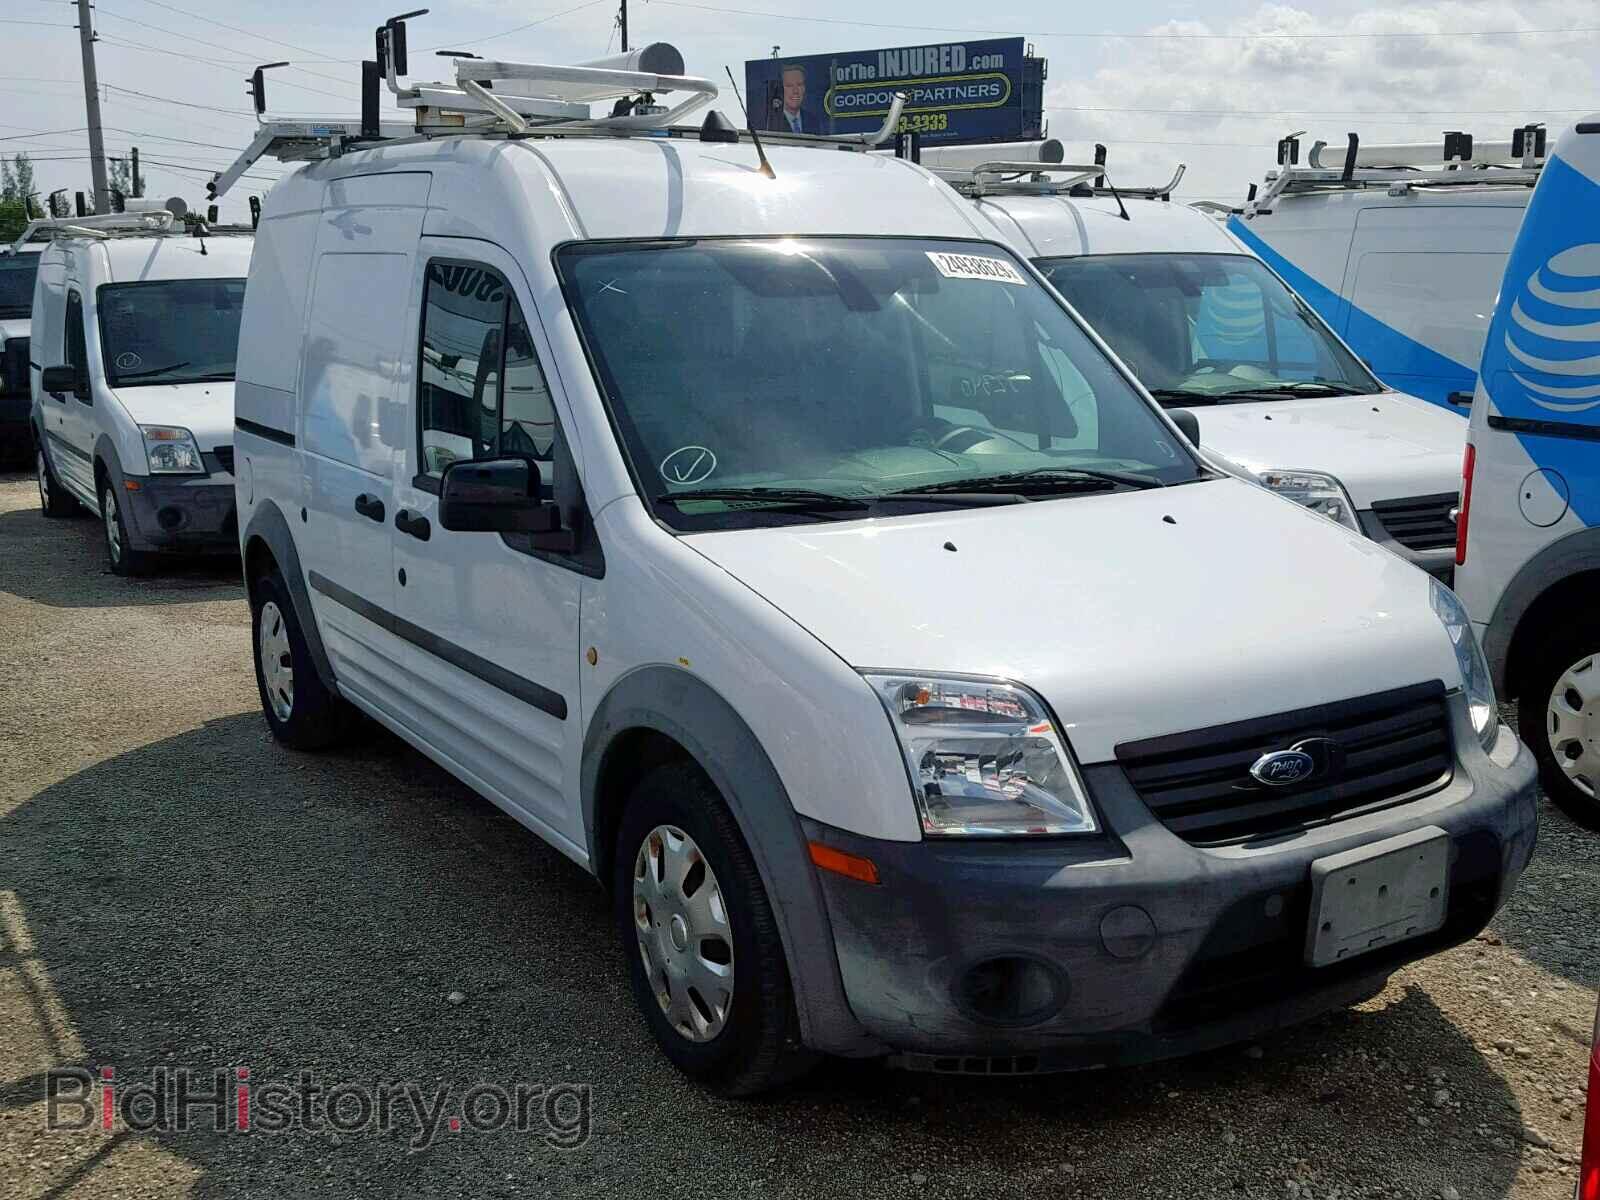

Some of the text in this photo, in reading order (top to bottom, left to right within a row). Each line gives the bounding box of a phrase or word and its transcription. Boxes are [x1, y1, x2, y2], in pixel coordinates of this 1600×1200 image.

[914, 83, 1000, 101] PARTNERS
[938, 254, 1013, 278] 24938629
[1270, 758, 1303, 778] Ford
